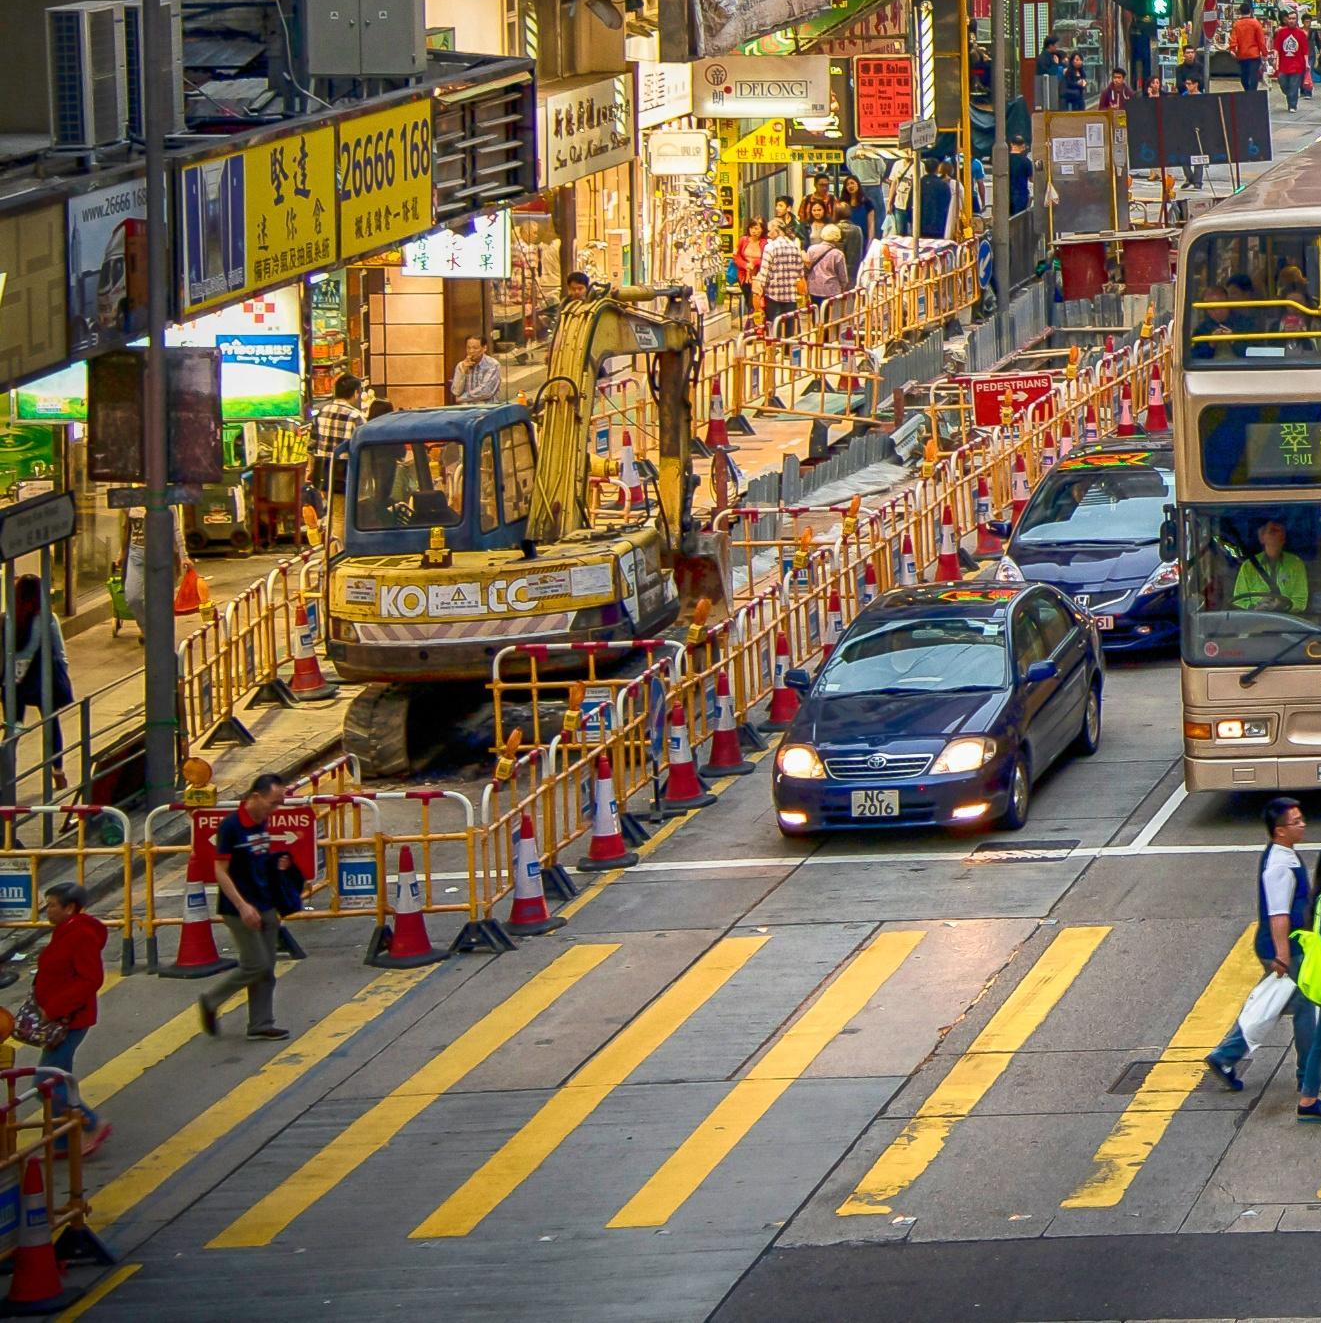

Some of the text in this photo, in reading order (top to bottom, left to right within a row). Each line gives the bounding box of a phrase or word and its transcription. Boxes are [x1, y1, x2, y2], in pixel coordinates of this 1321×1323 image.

[738, 82, 805, 97] DELONG
[340, 118, 431, 203] 26666 168
[736, 147, 764, 160] 世界
[976, 378, 1049, 393] PEDESTRIANS
[1284, 453, 1313, 465] TSUI
[863, 791, 885, 803] NC
[858, 803, 895, 816] 2016
[0, 884, 25, 900] am
